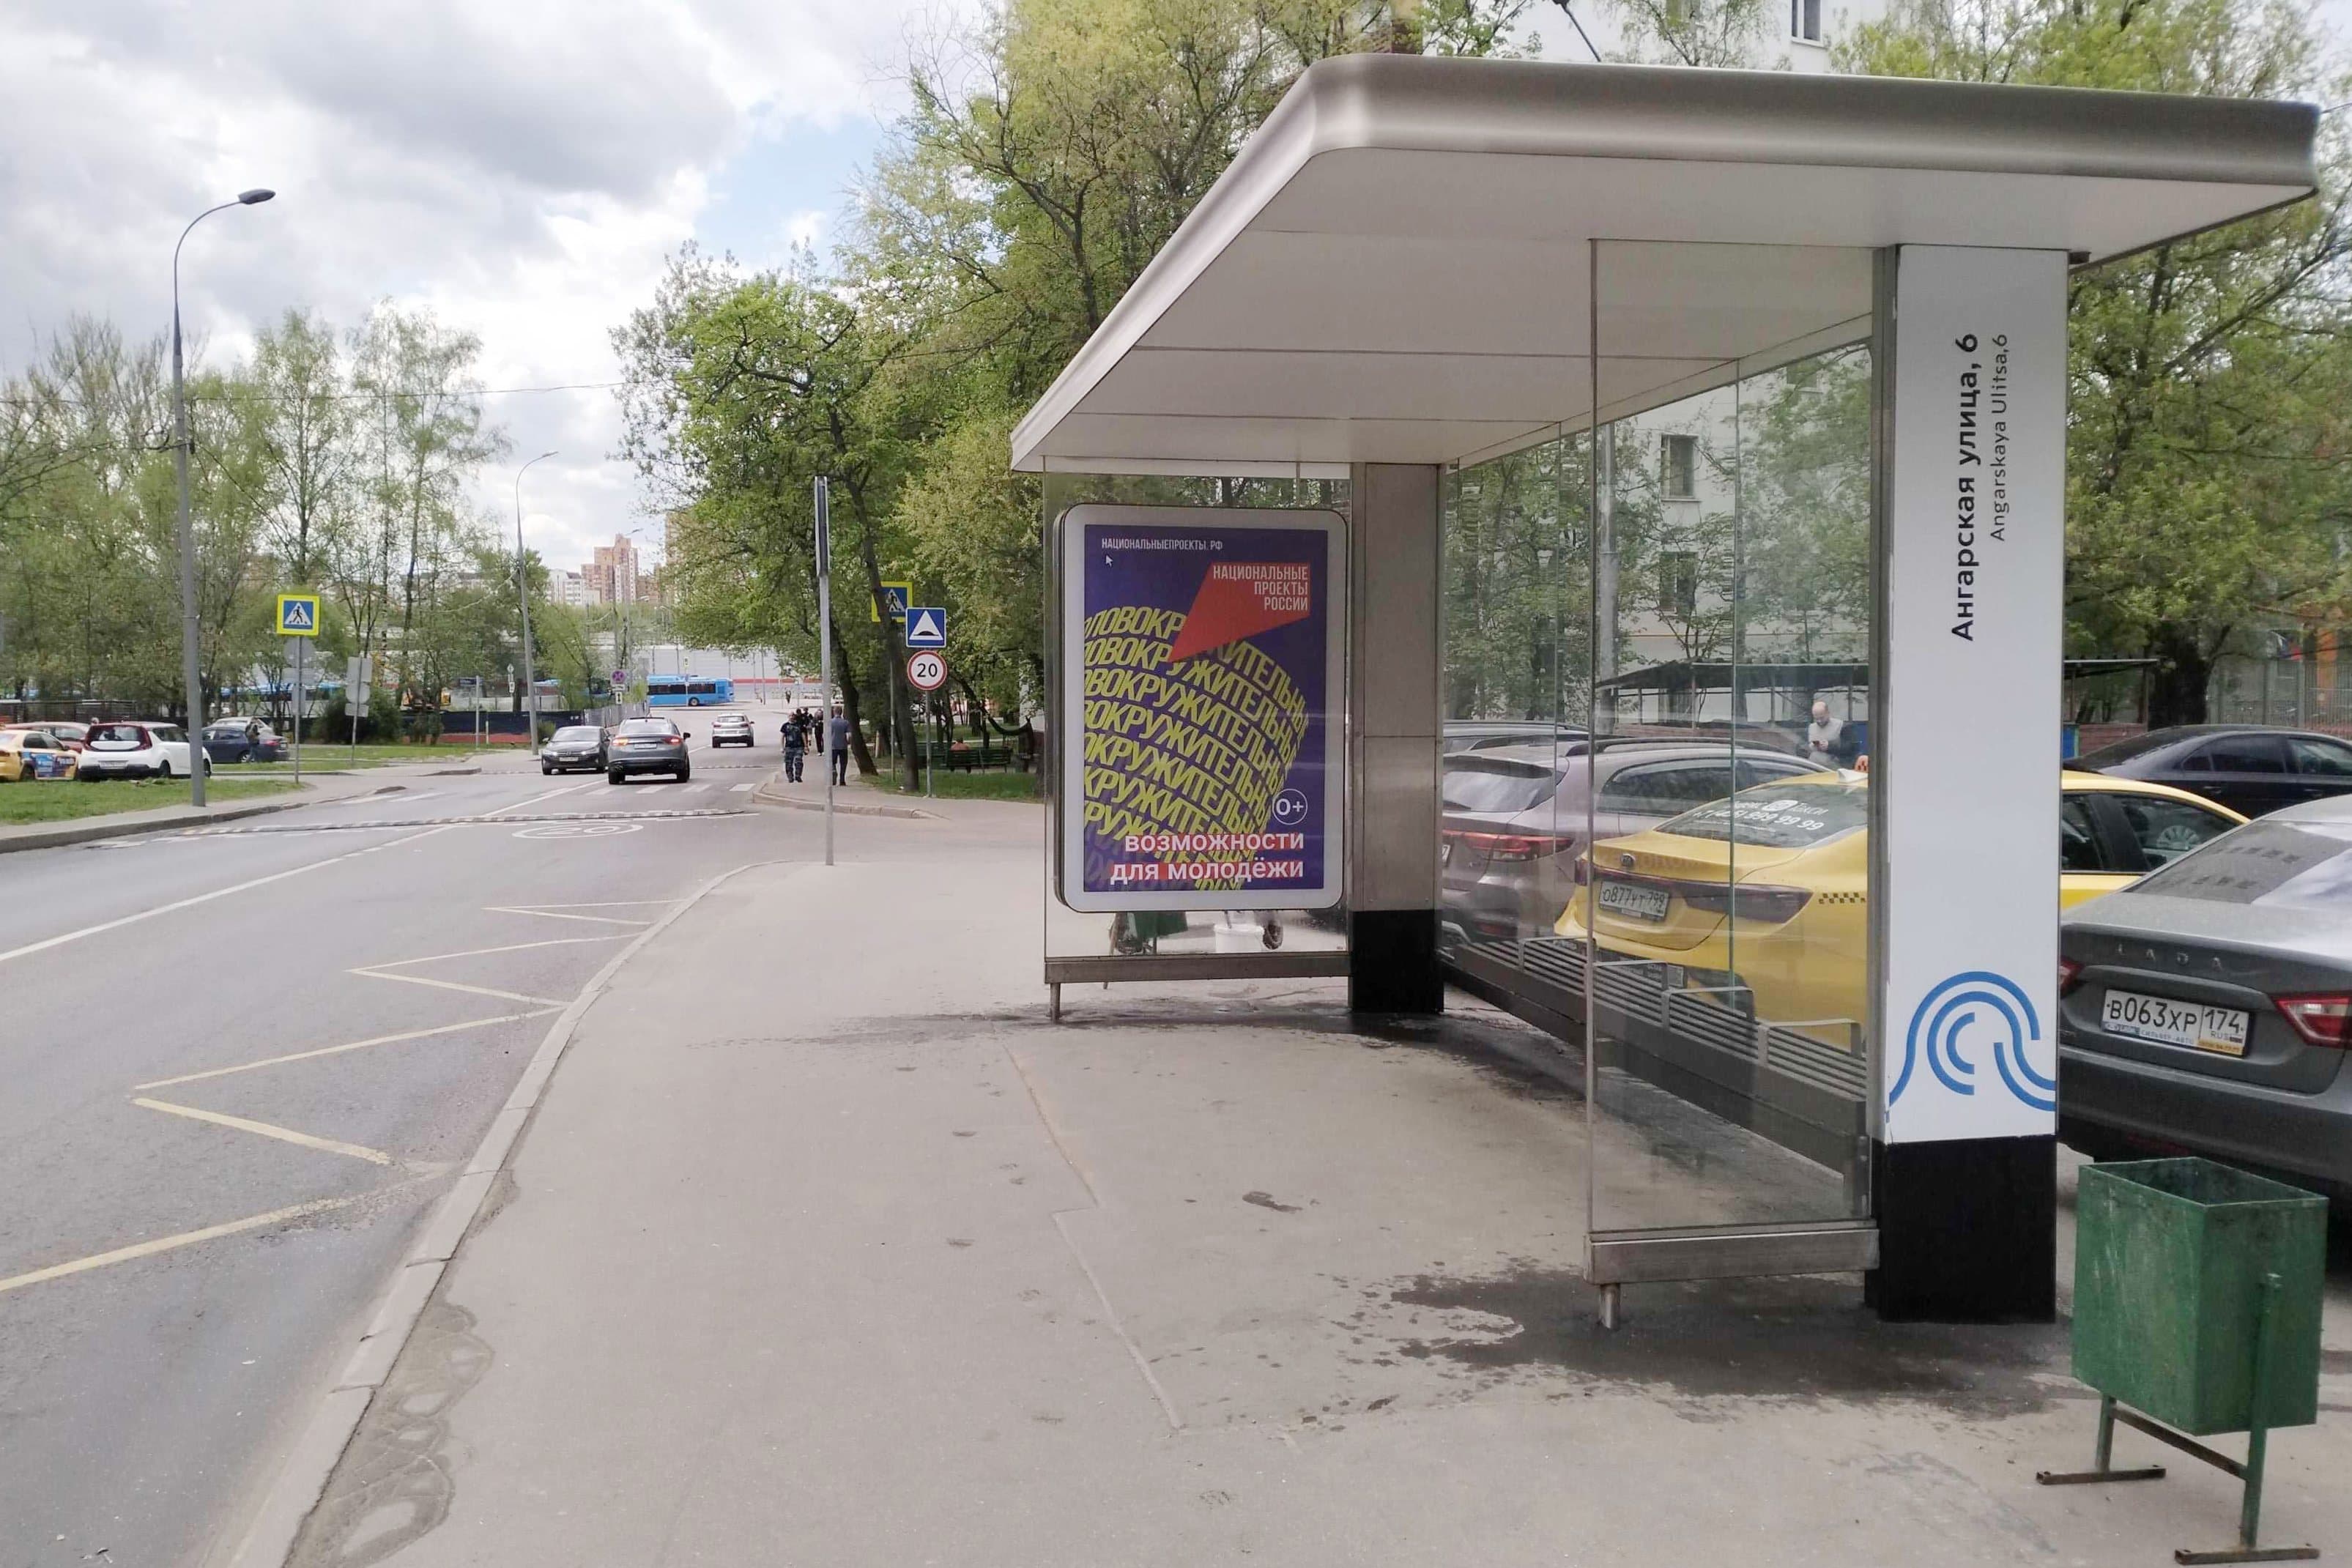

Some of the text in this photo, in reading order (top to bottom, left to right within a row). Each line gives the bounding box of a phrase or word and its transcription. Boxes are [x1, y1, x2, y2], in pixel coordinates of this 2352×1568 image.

[1951, 333, 1981, 642] Ангарская улица, 6
[1989, 420, 2010, 542] Angarskaya
[1213, 565, 1308, 581] НАЦИОНАЛЬНЫЕ
[1254, 581, 1308, 595] ПРОЕКТЫ
[1264, 597, 1308, 612] РОССИИ
[917, 663, 938, 677] 20
[1275, 798, 1304, 816] 0+
[1743, 811, 1778, 822] 999
[1774, 815, 1801, 825] 99
[1797, 820, 1825, 831] 99
[1110, 863, 1159, 885] для
[1168, 856, 1304, 883] молодёжи
[2118, 943, 2224, 972] LADA
[2204, 1008, 2241, 1034] 174
[2210, 1030, 2230, 1040] RUS
